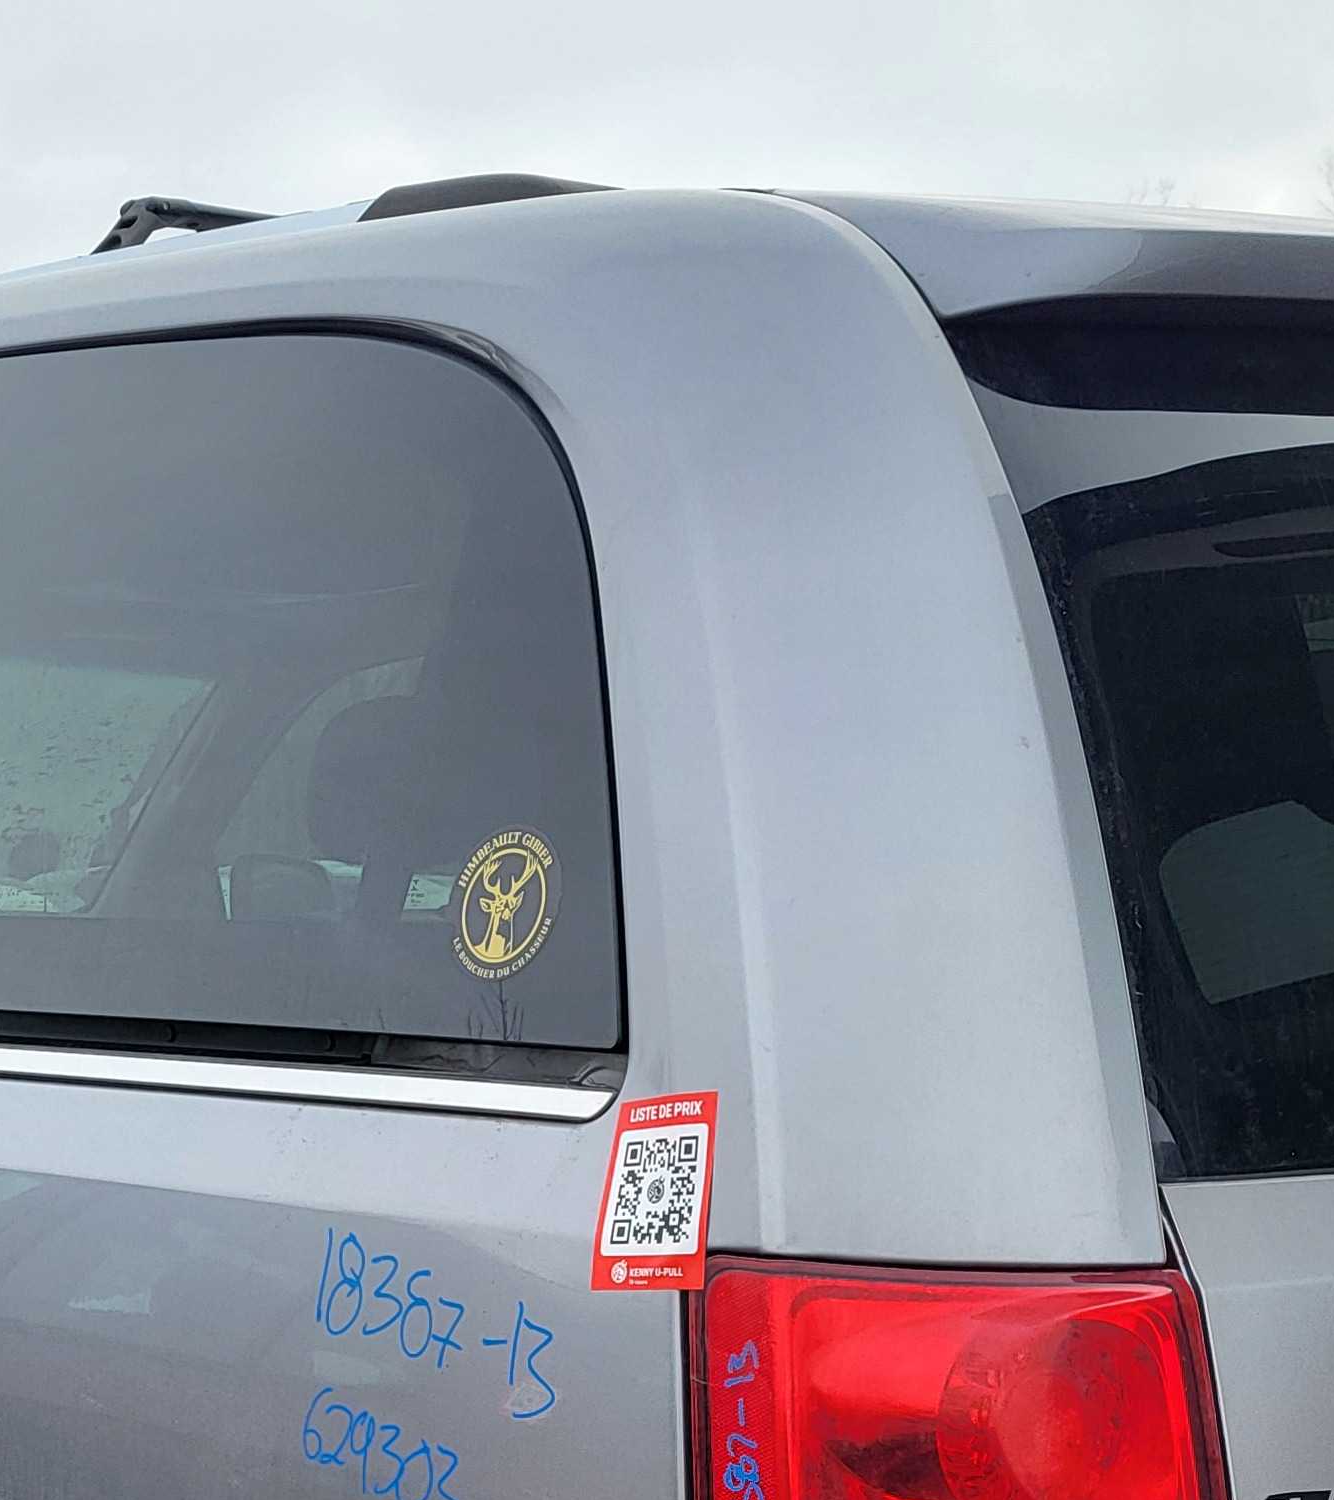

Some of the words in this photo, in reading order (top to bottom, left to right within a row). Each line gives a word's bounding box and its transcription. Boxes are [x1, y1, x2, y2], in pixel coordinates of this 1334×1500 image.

[522, 833, 555, 869] GIBIER
[452, 936, 461, 953] LE
[458, 952, 495, 979] BOUCHER
[496, 967, 510, 979] DU
[511, 917, 553, 973] CHASSEUR
[629, 1104, 659, 1123] LISTE
[658, 1102, 674, 1119] DE
[673, 1099, 704, 1117] PRIX
[628, 1267, 655, 1278] KENNY
[654, 1267, 684, 1277] U-PULL
